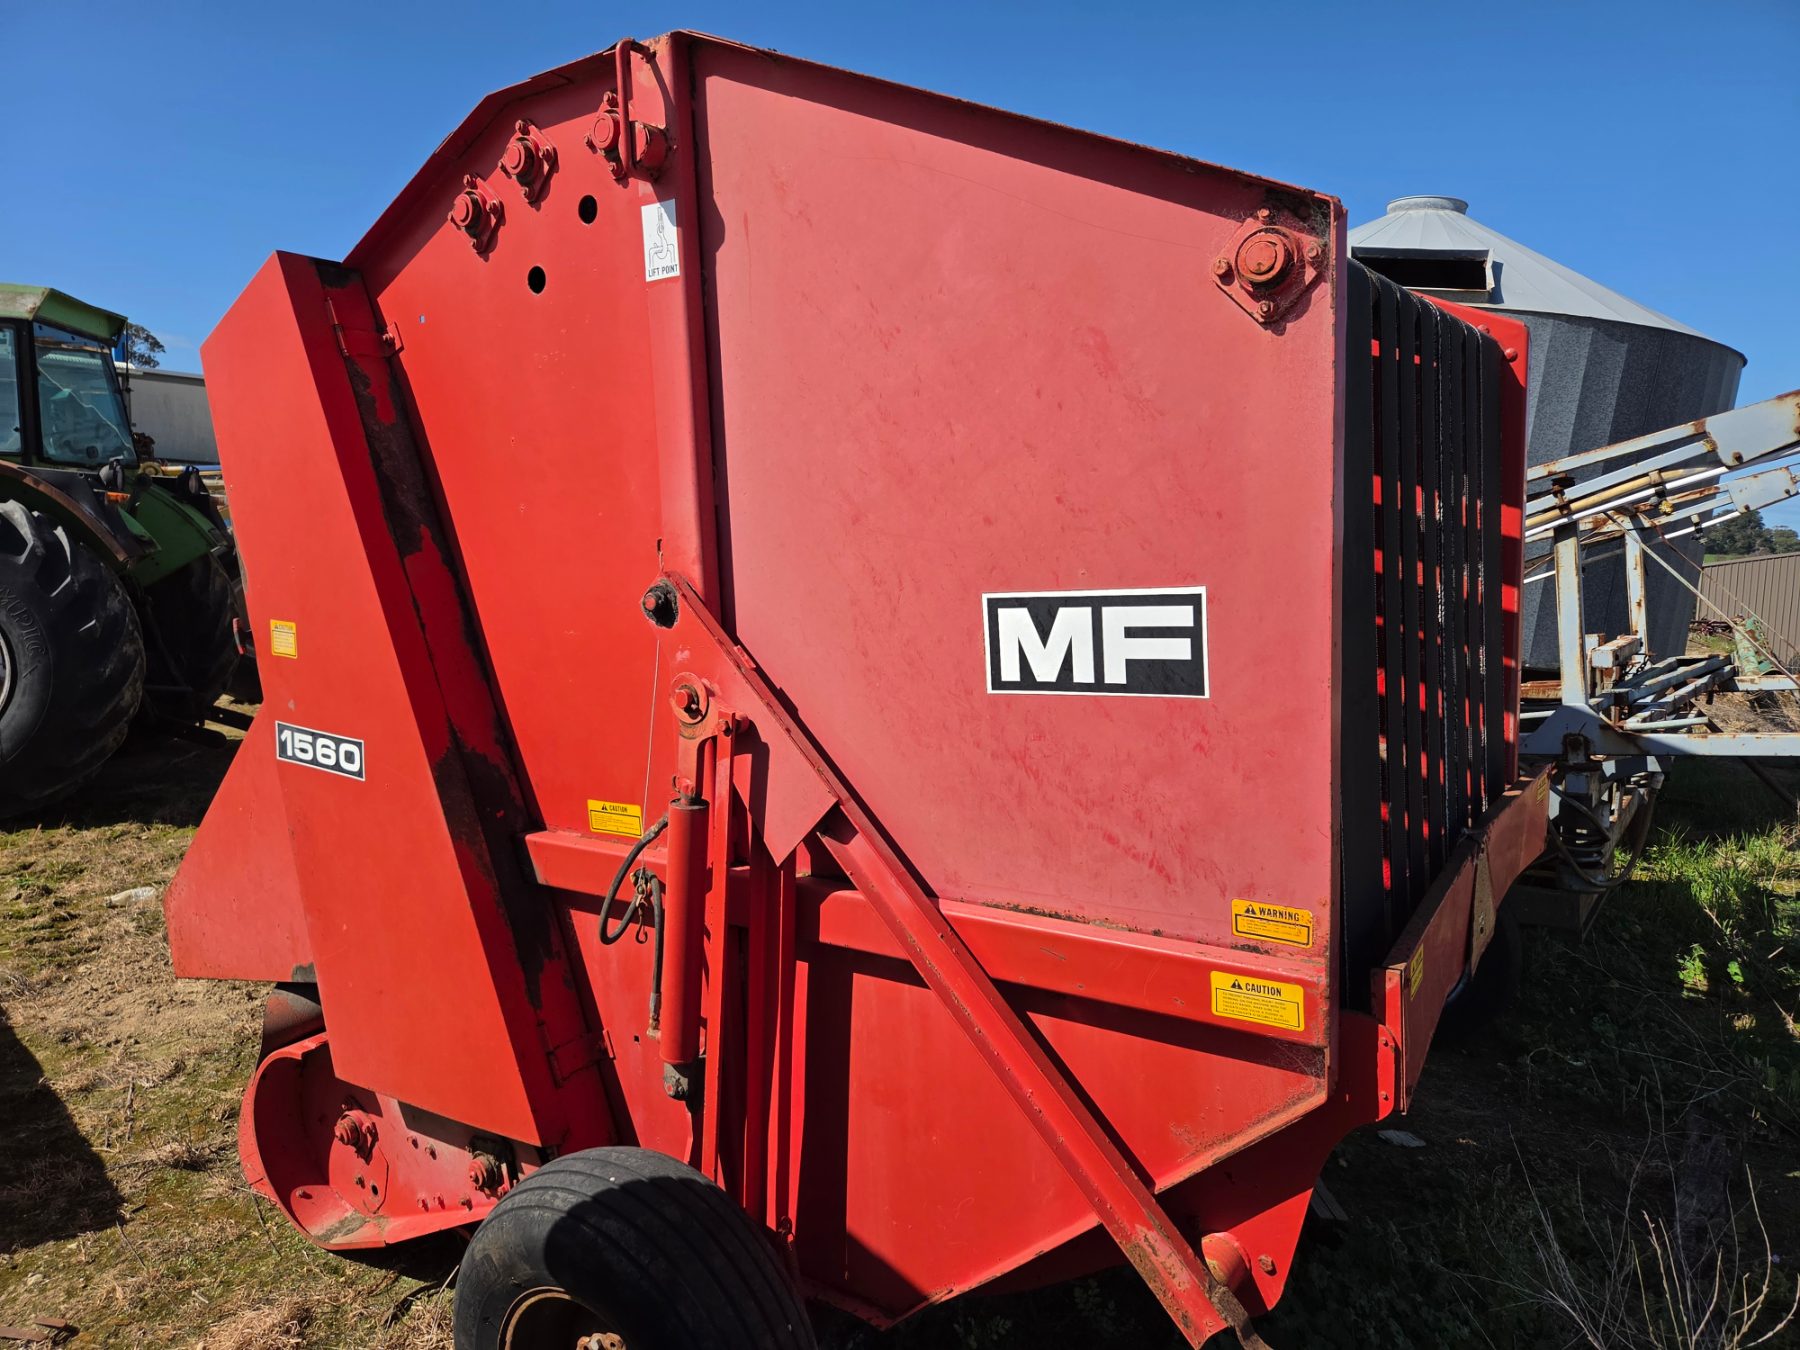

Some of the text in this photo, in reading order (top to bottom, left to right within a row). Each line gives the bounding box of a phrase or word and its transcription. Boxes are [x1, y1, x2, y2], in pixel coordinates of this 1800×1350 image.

[648, 264, 678, 278] LIFT POINT
[998, 605, 1194, 684] MF
[280, 729, 361, 772] 1560
[1258, 906, 1300, 922] WARNING
[1245, 982, 1282, 997] CAUTION
